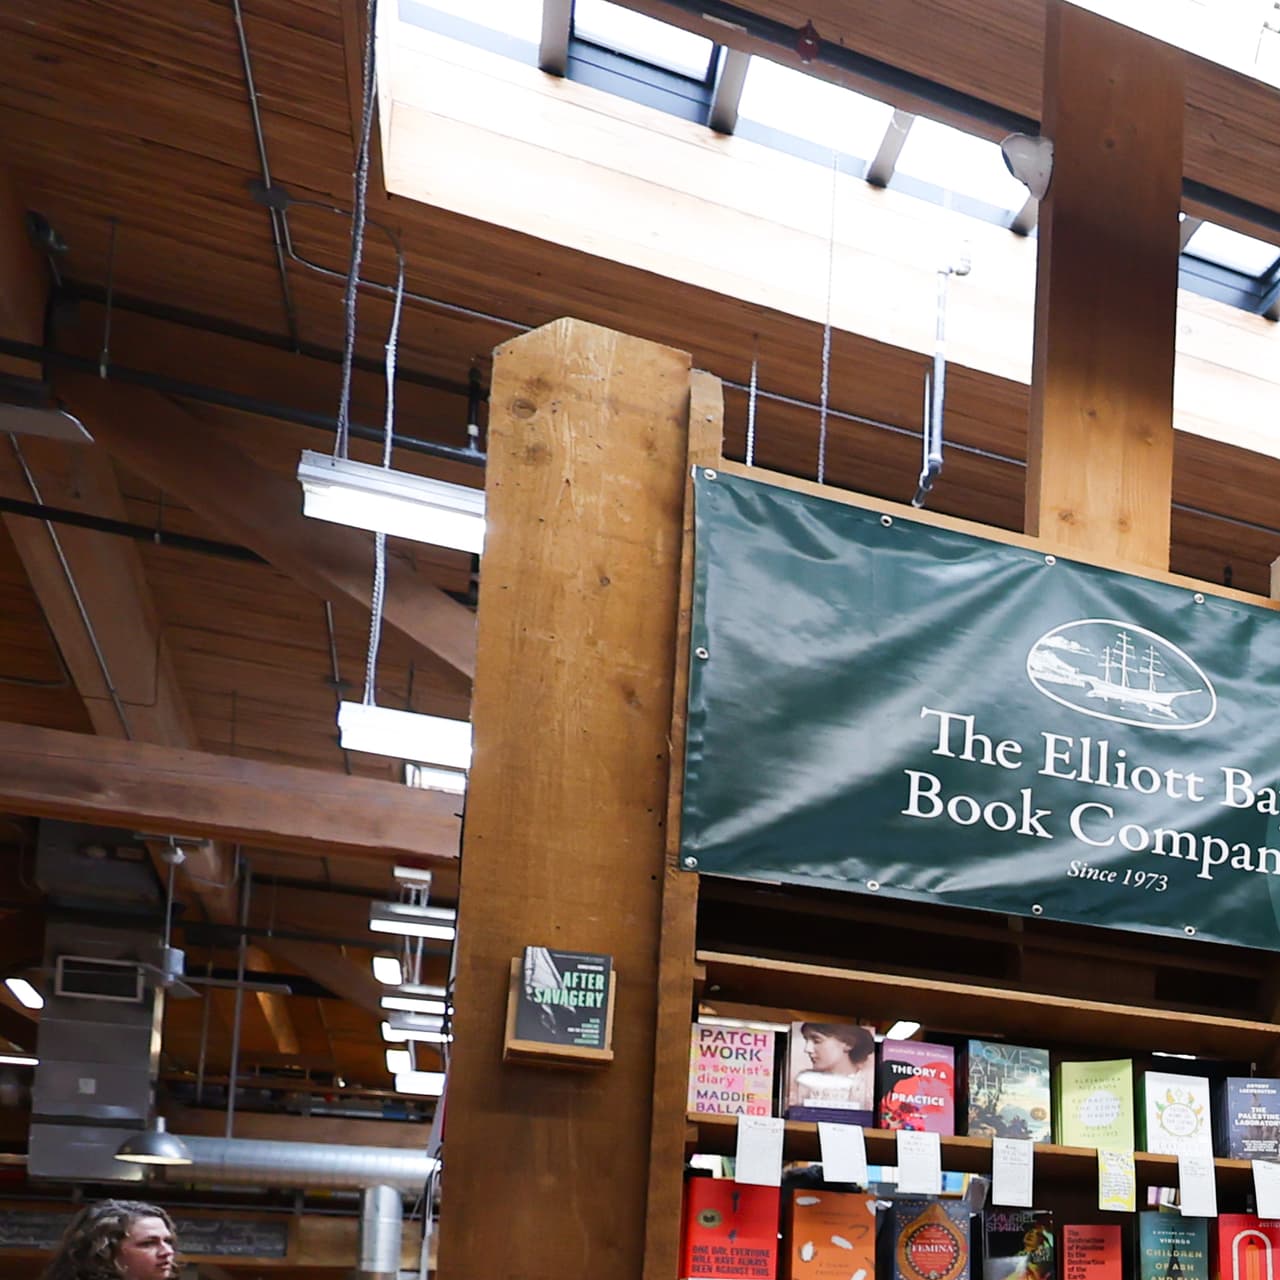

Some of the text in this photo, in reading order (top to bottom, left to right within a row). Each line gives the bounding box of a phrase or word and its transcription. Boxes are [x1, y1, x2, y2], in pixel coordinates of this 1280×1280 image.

[920, 706, 1023, 769] The
[1038, 732, 1204, 803] Elliott
[902, 769, 1054, 840] Book
[1067, 860, 1168, 892] Since 1973
[563, 971, 604, 989] AFTER
[534, 988, 604, 1008] SAVAGERY
[700, 1029, 767, 1047] PATCH
[700, 1045, 762, 1062] WORK
[891, 1064, 946, 1080] THEORY &
[696, 1089, 755, 1102] MADDIE
[891, 1093, 945, 1106] PRACTICE
[696, 1102, 766, 1116] BALLARD
